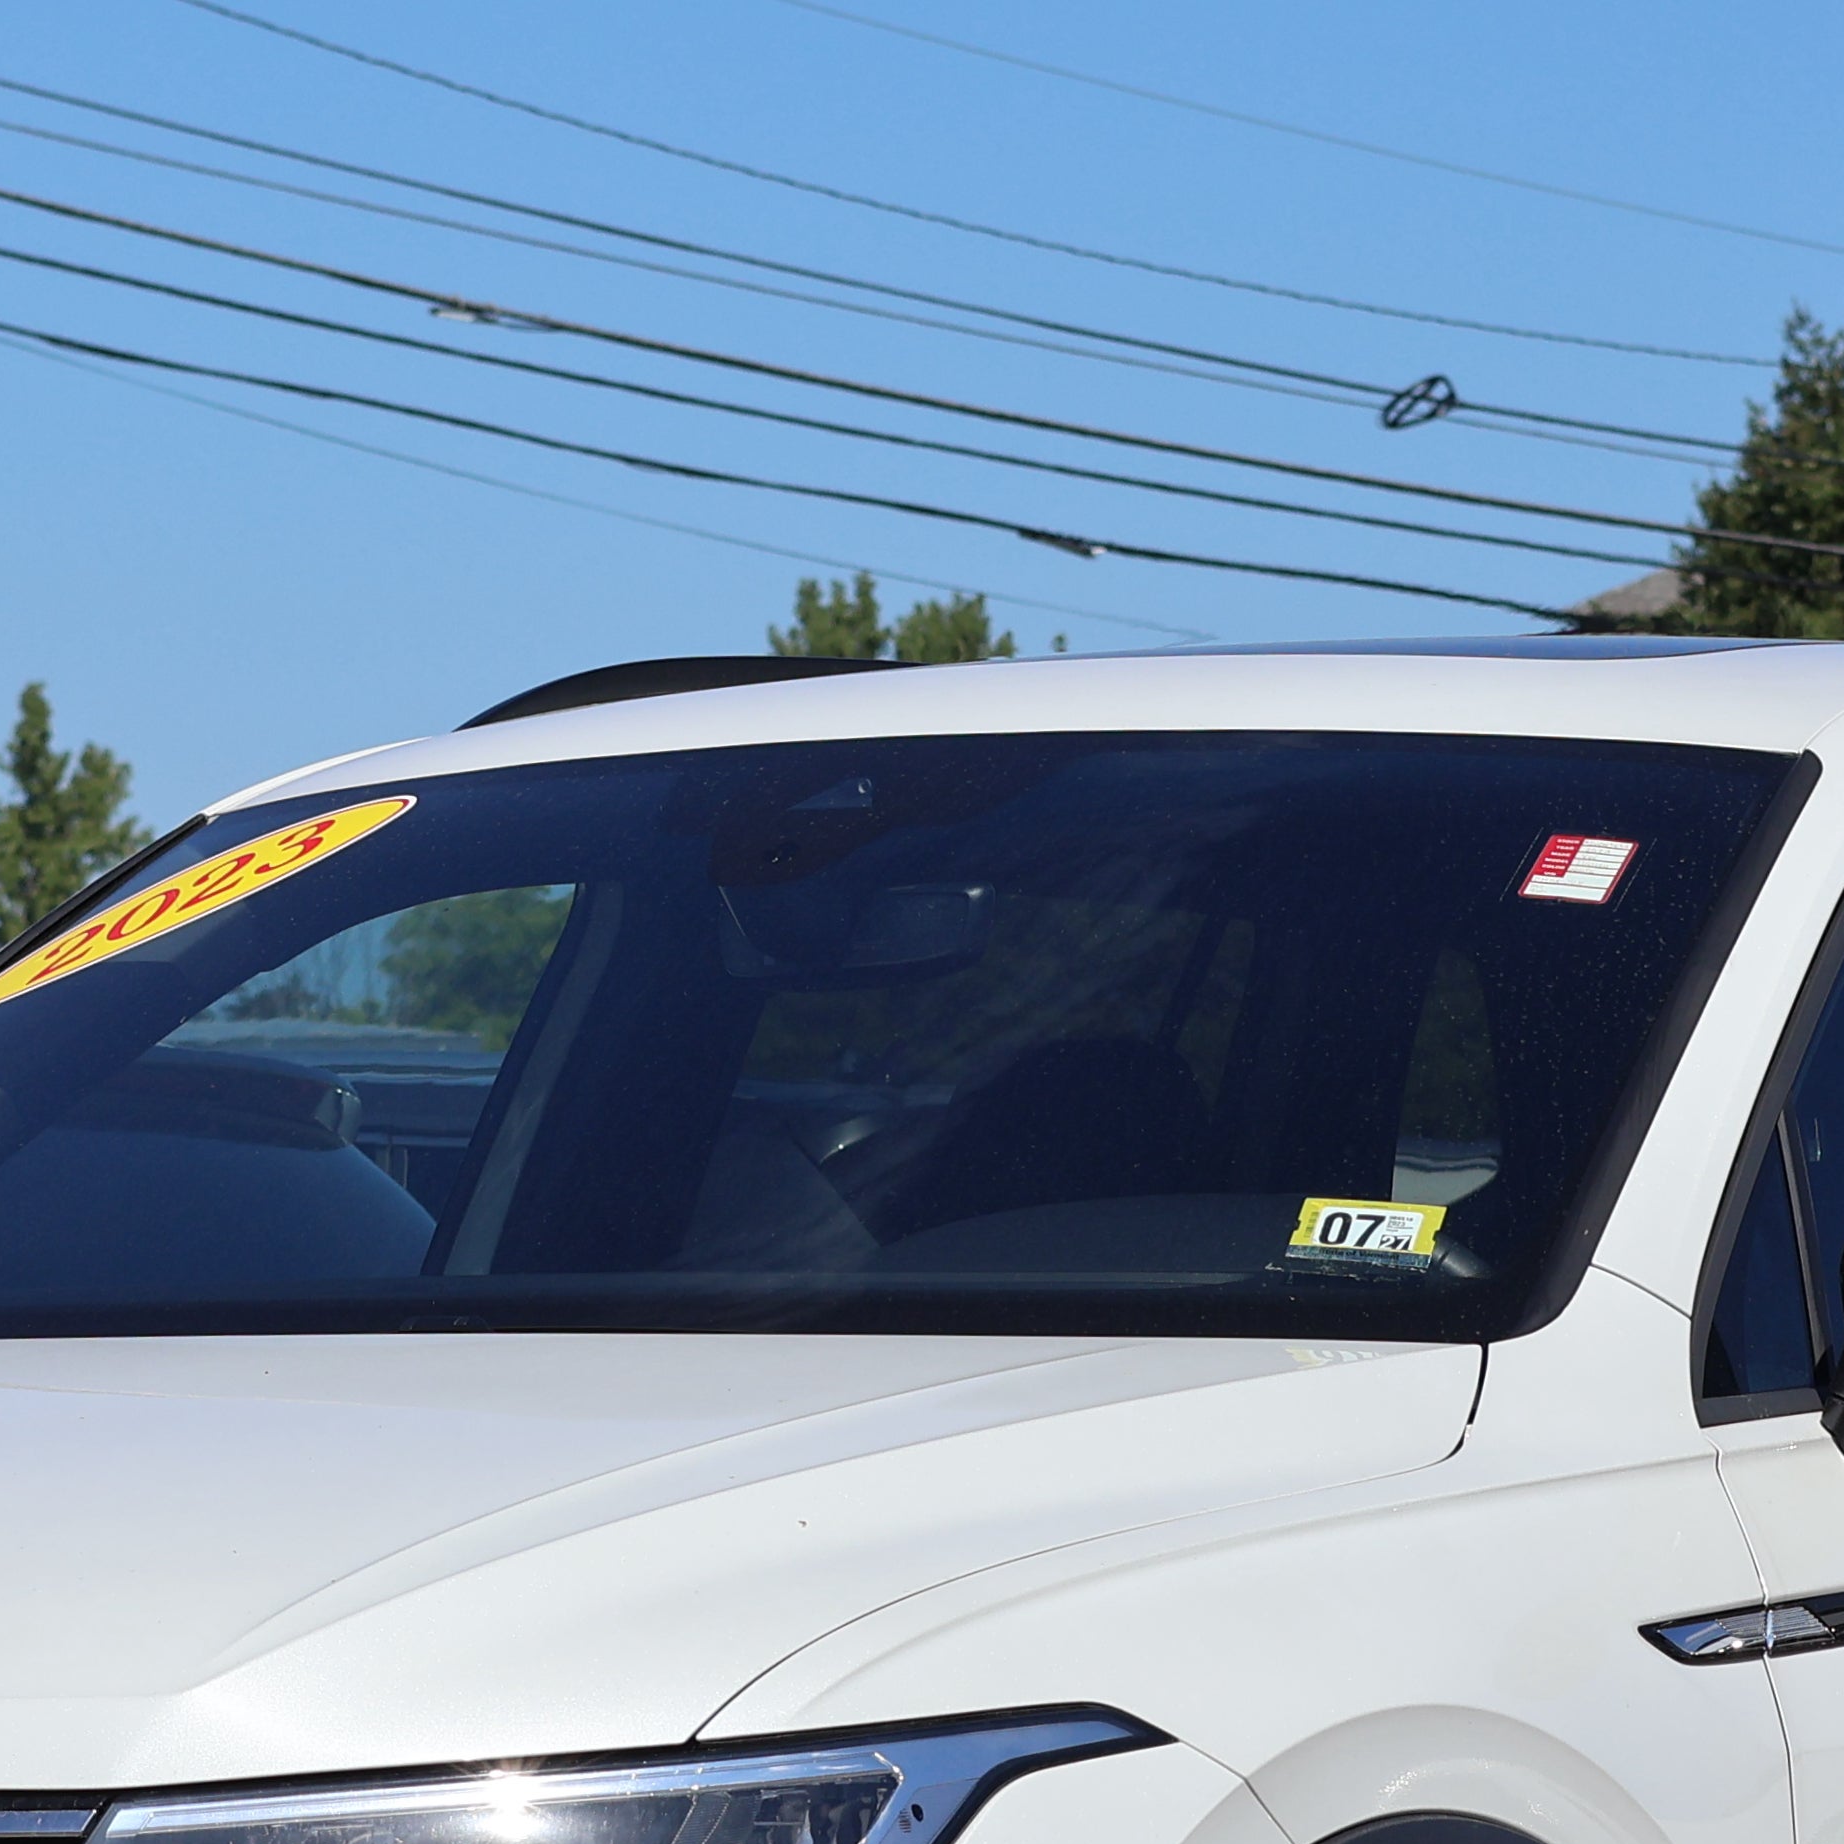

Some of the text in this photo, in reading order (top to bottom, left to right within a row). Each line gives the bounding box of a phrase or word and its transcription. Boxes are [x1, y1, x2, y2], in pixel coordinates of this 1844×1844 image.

[26, 819, 336, 985] 2023
[1319, 1212, 1386, 1248] 07
[1380, 1235, 1411, 1250] 27
